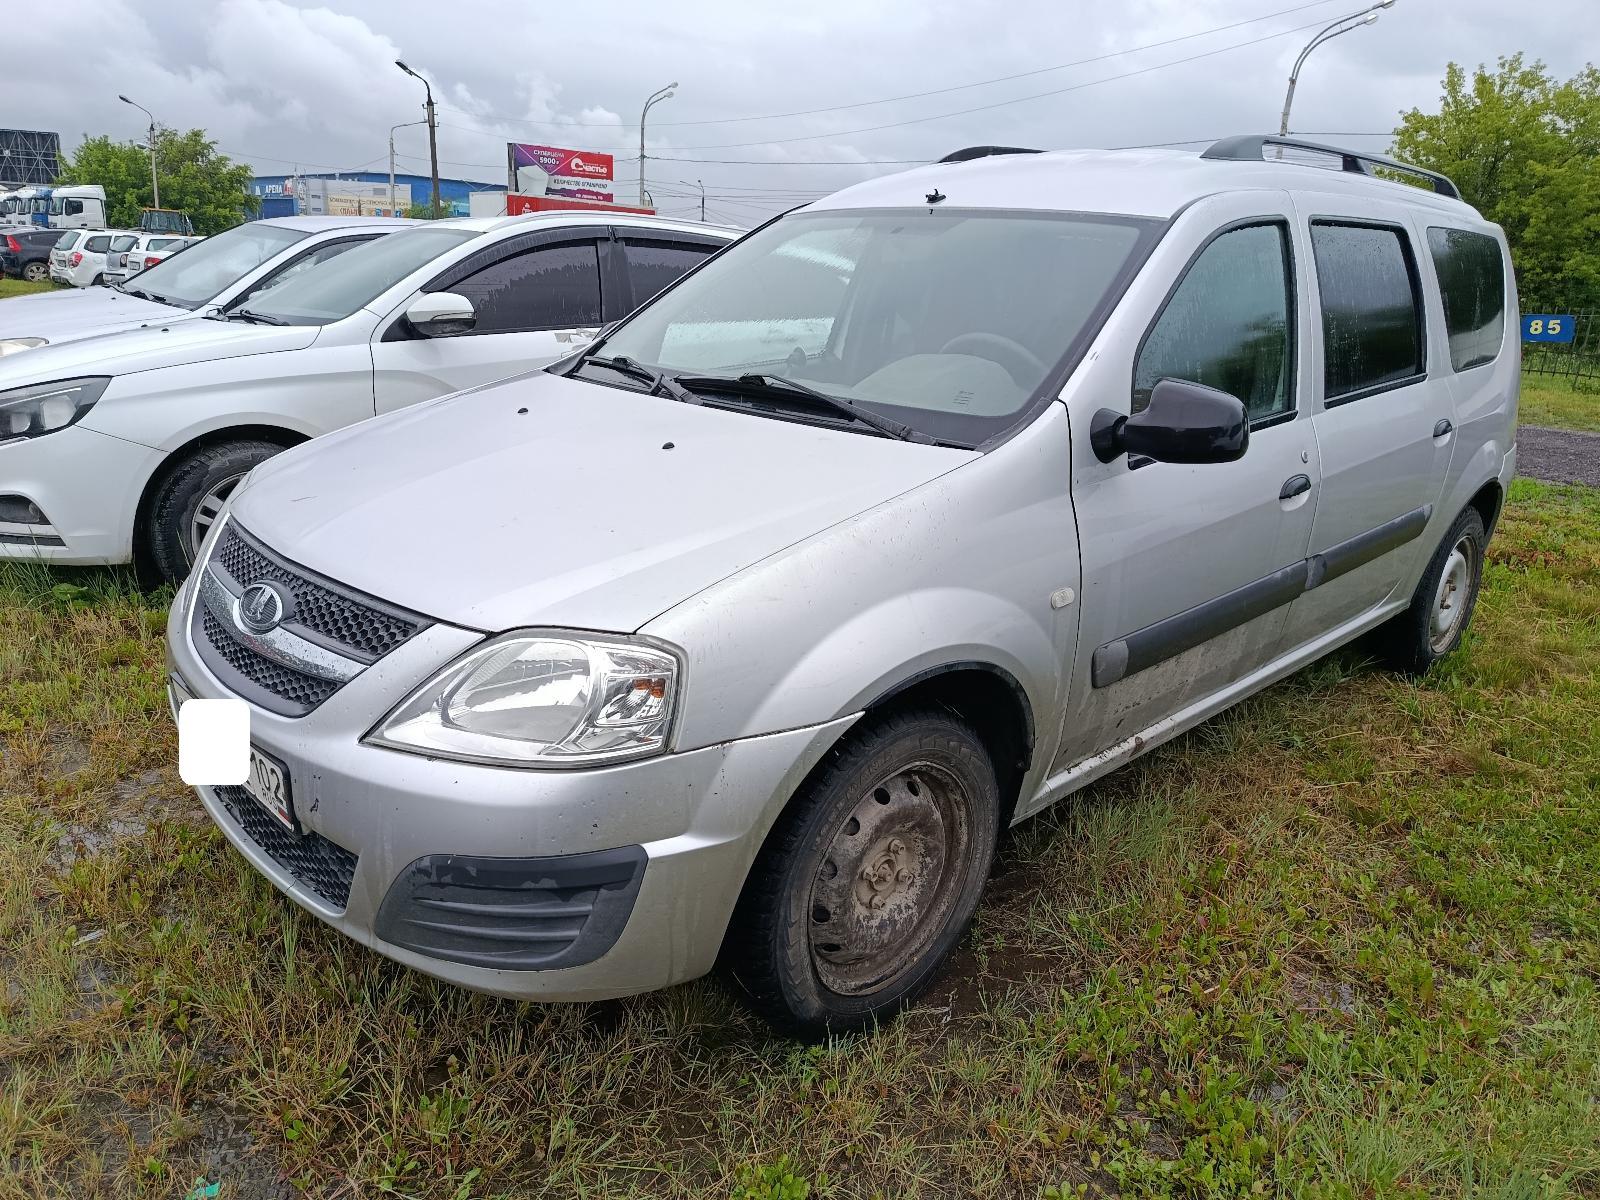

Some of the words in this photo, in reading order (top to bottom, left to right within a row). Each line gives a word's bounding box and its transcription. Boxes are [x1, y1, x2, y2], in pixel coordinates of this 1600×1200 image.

[533, 149, 565, 158] СУПЕРЦЕНА
[264, 184, 283, 194] АРЕНА
[1529, 319, 1561, 335] 85
